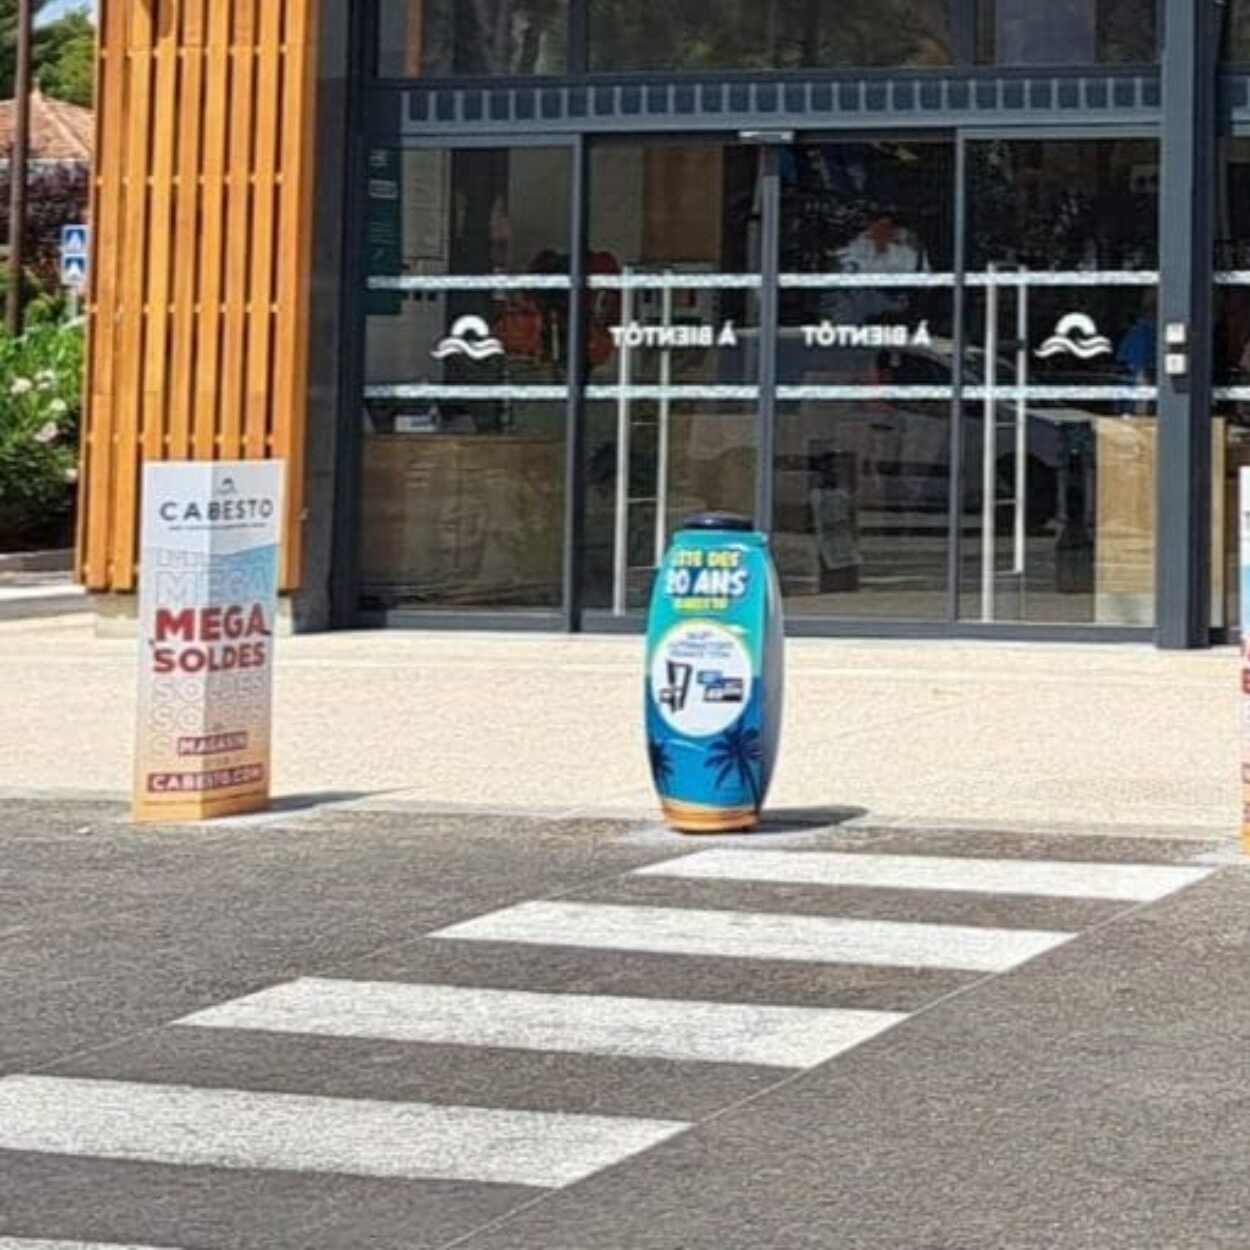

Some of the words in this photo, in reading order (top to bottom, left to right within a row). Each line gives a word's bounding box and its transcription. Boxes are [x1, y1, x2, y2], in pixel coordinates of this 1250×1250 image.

[159, 499, 274, 521] CABESTO
[693, 568, 747, 596] ANS
[155, 602, 267, 642] MEGA
[153, 642, 265, 673] SOLDES
[152, 766, 260, 791] CABESTO.COM
